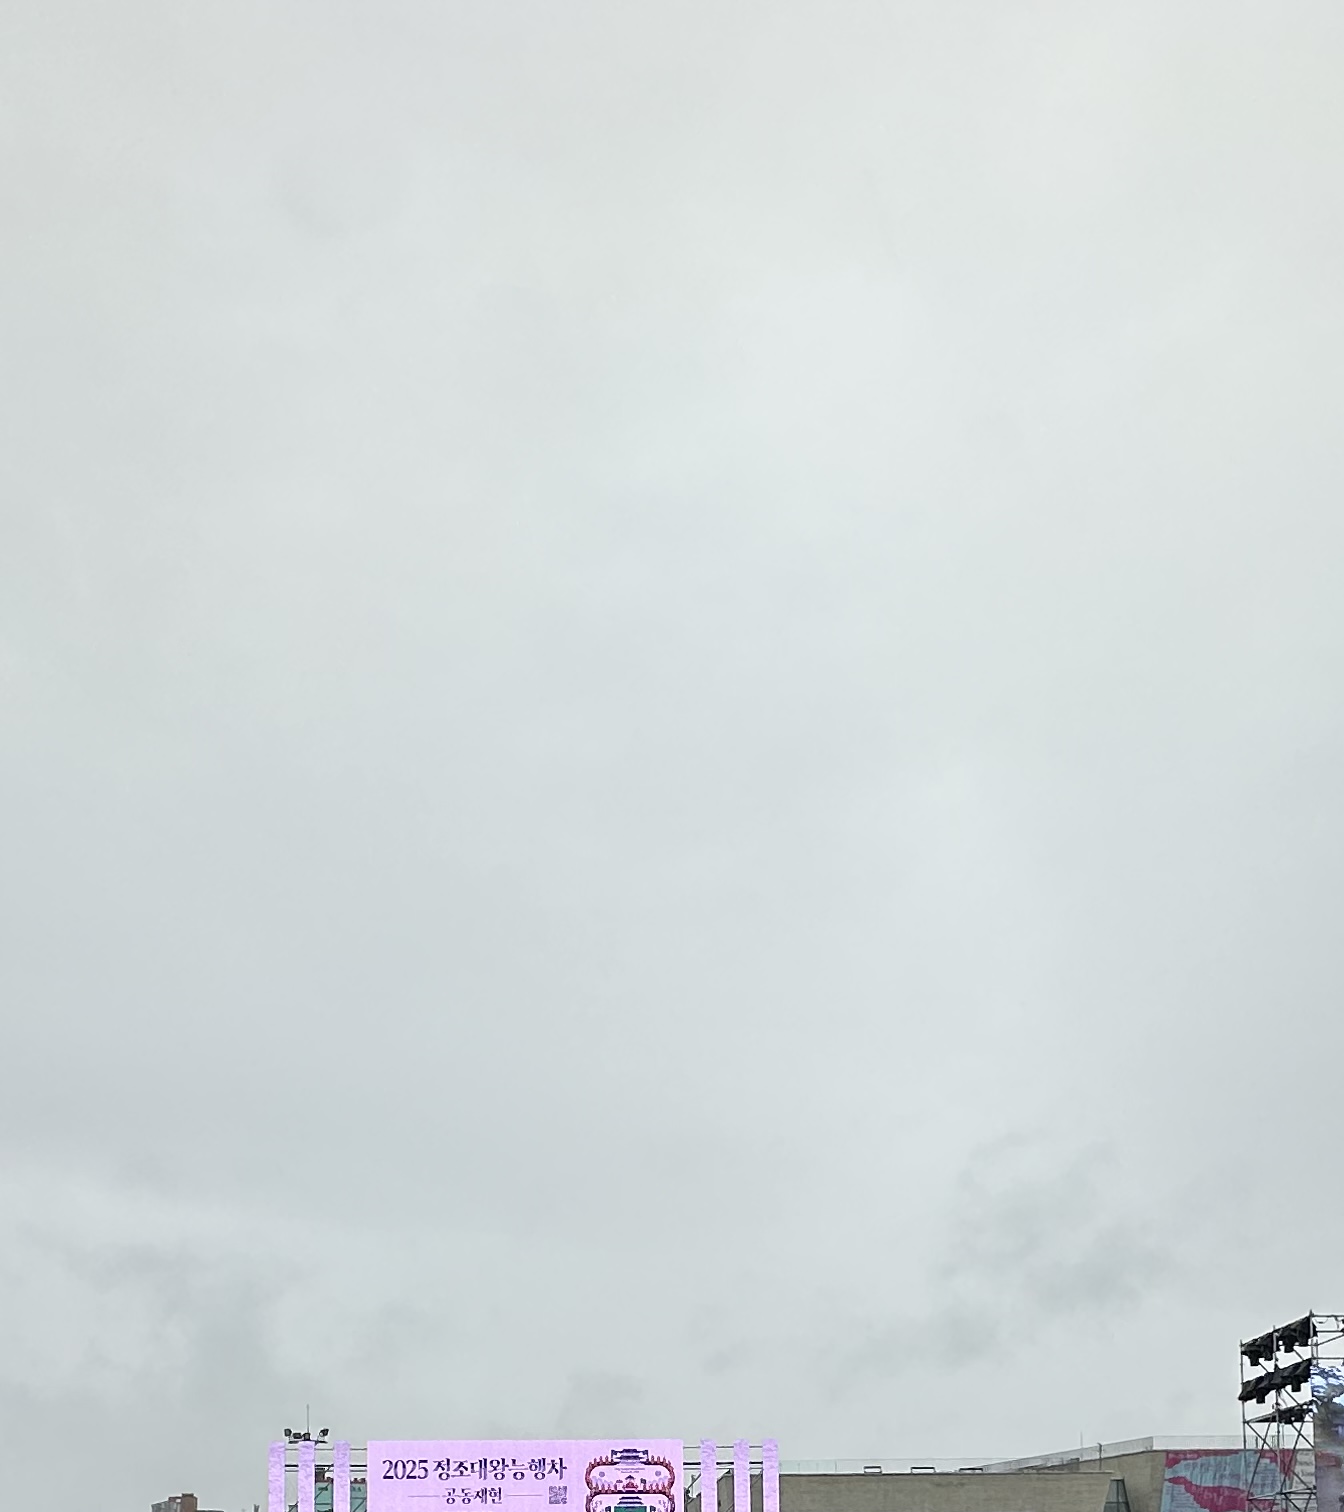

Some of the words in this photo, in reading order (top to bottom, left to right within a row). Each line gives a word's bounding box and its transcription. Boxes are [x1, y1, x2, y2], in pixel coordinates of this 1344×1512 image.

[382, 1459, 429, 1480] 2025
[433, 1457, 568, 1481] 정조대왕능행차
[442, 1486, 503, 1505] 공동재현
